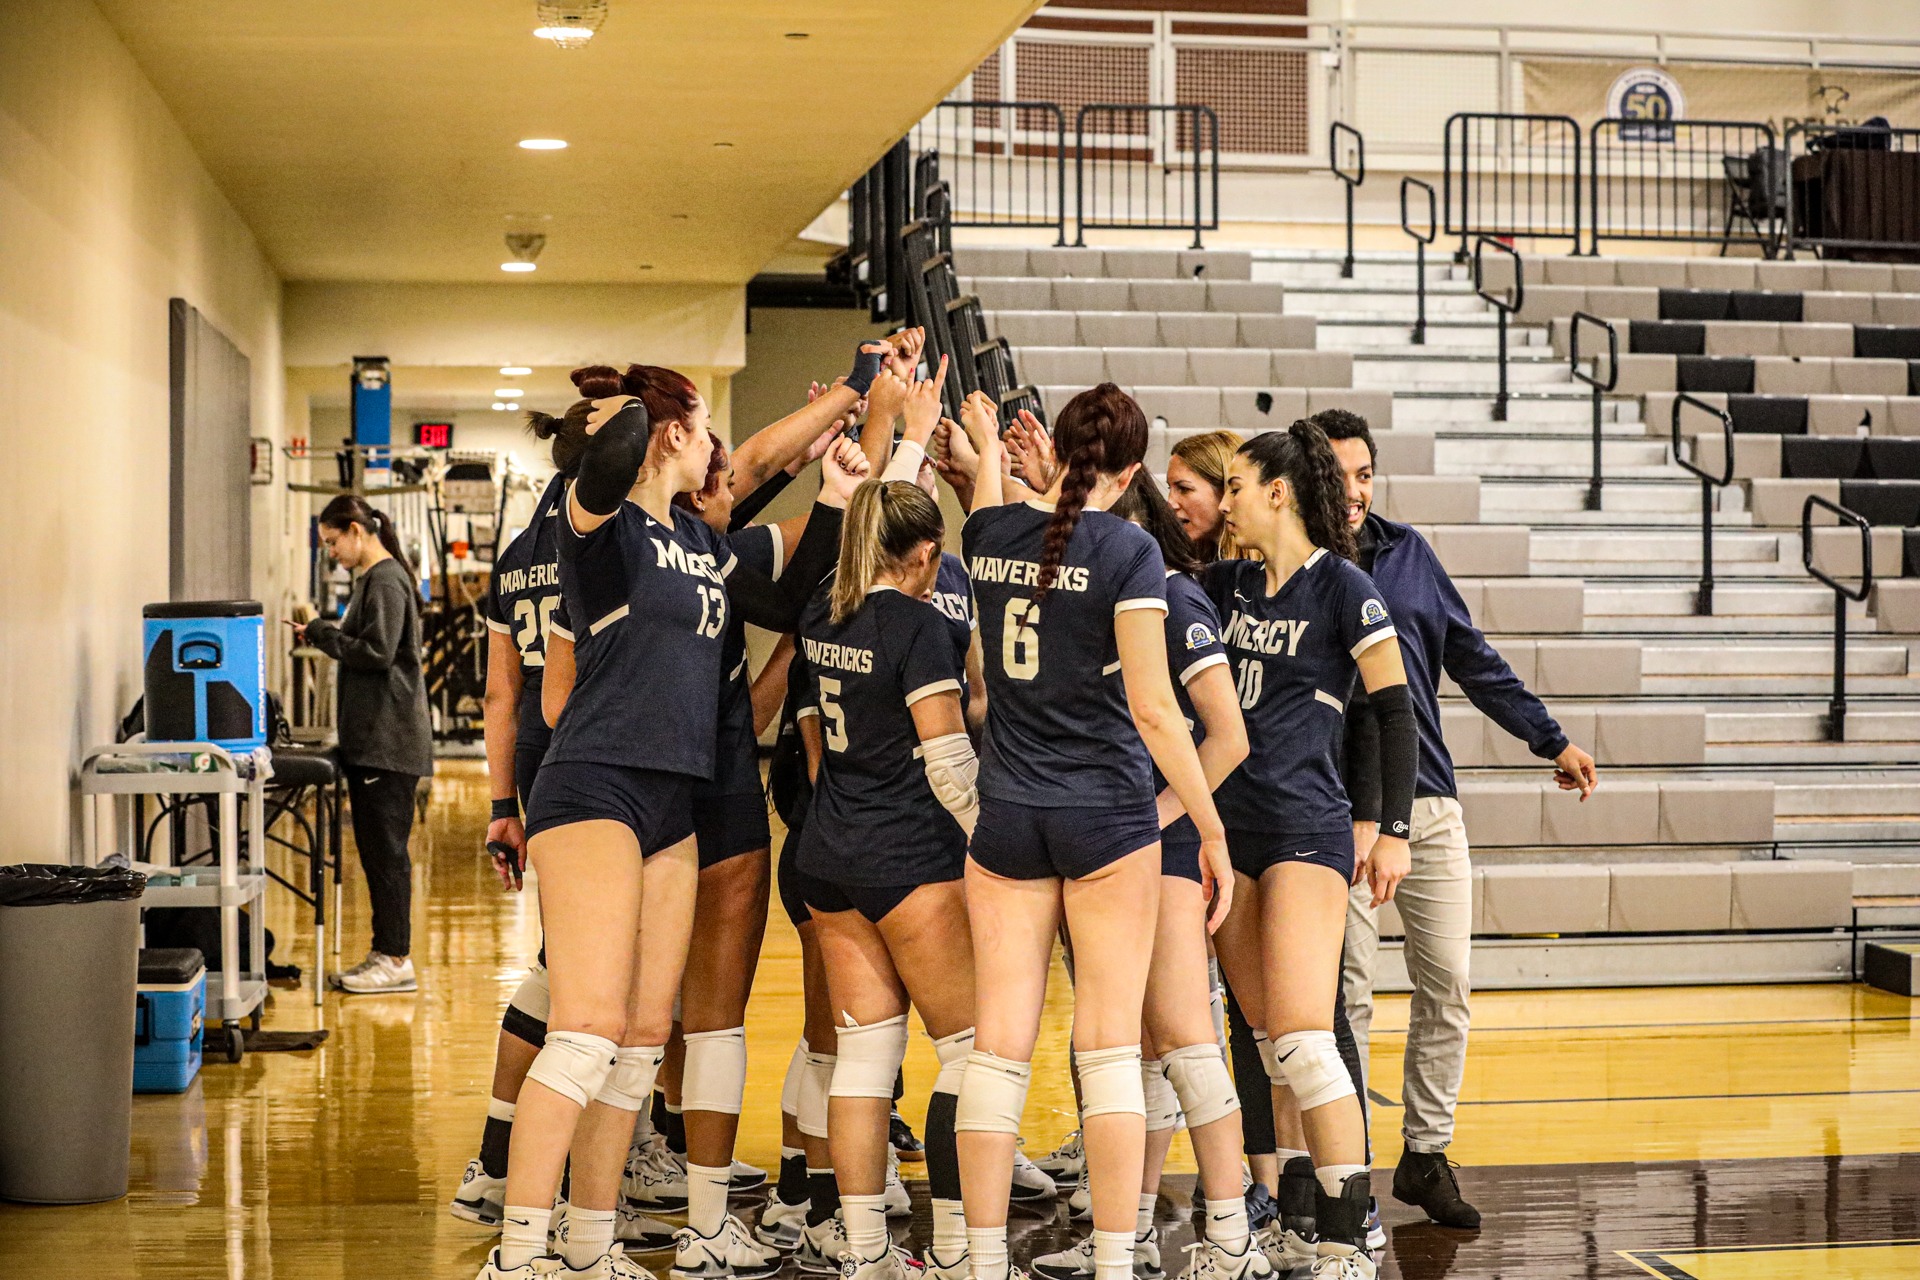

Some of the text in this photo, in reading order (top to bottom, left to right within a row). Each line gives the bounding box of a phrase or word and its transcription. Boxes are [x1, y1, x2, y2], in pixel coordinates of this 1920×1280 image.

[1627, 93, 1667, 121] 50
[500, 563, 559, 595] MAVERIC
[971, 556, 1090, 592] MAVERKS
[697, 584, 726, 639] 13
[931, 591, 970, 623] RCY
[1003, 597, 1040, 680] 6
[1221, 609, 1310, 656] MERCY
[802, 636, 873, 674] AVERICKS
[1237, 658, 1264, 709] 10
[819, 675, 849, 753] 5
